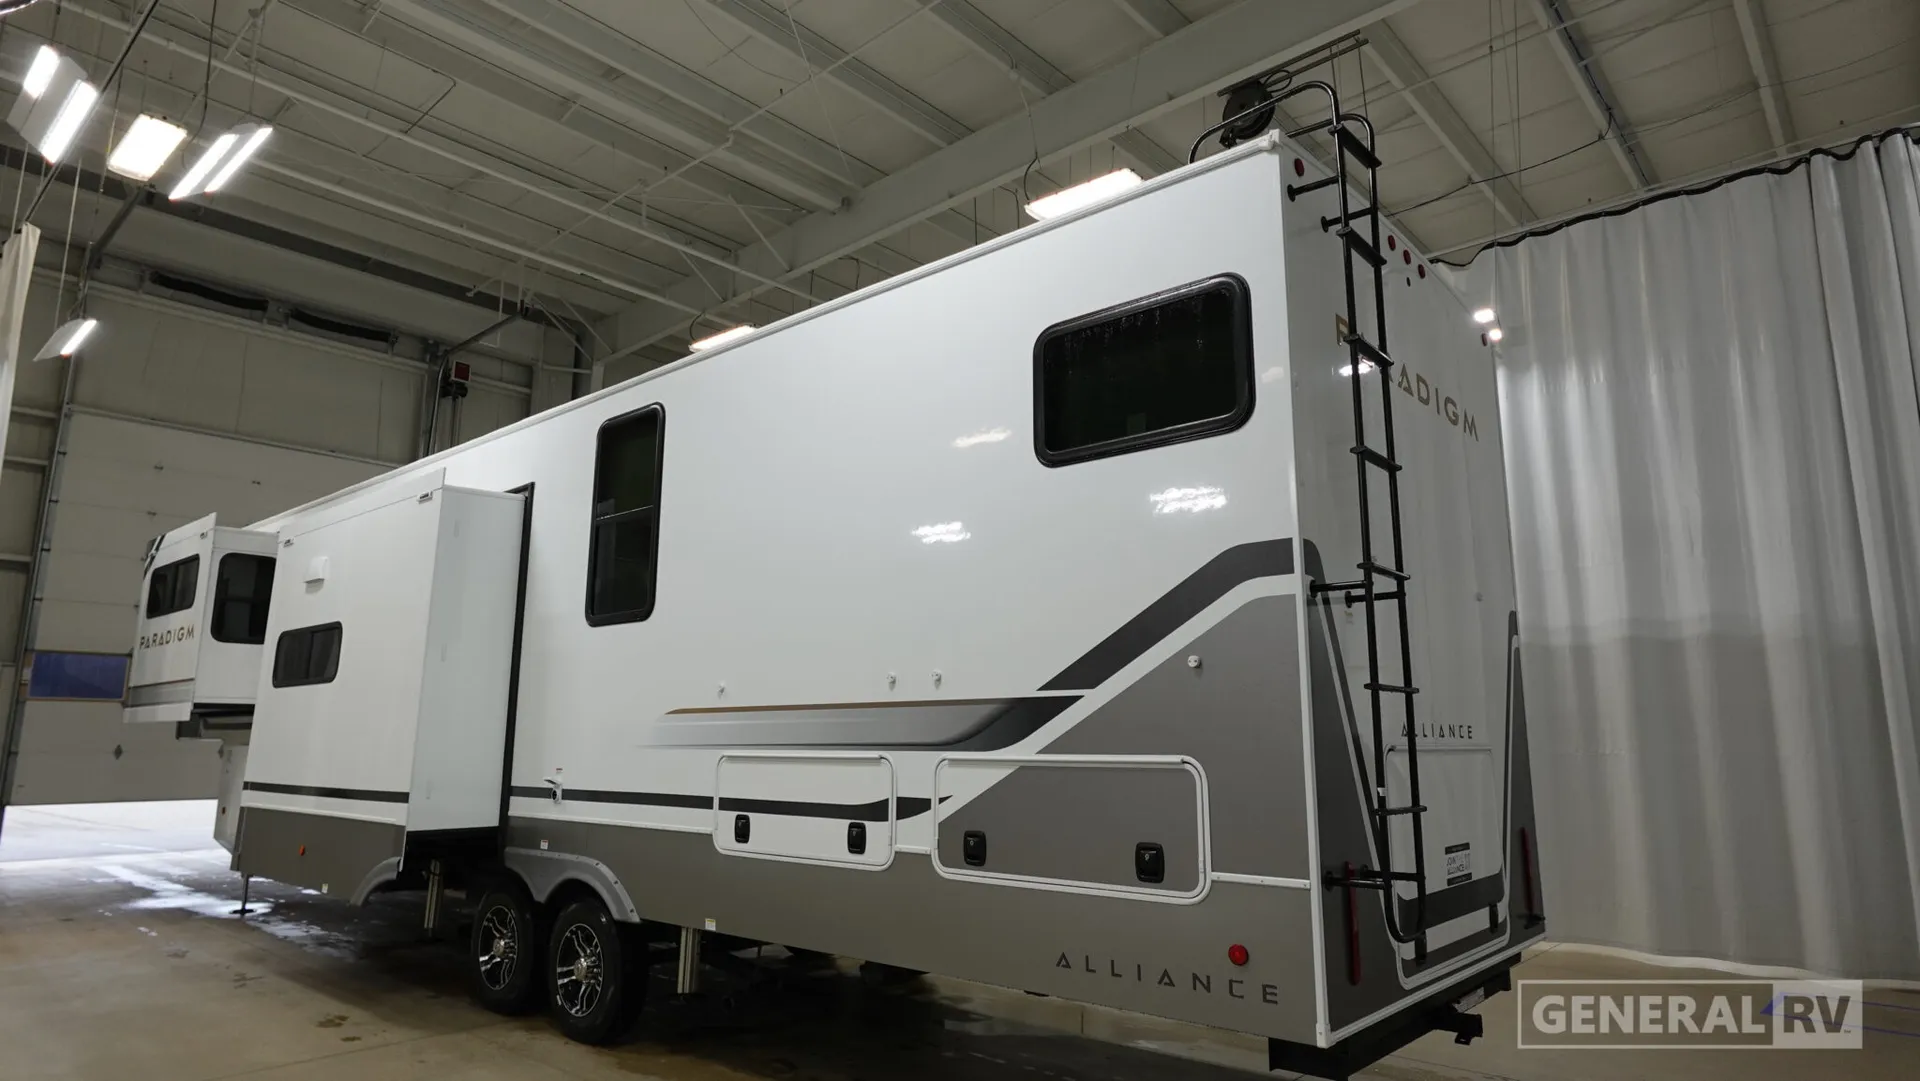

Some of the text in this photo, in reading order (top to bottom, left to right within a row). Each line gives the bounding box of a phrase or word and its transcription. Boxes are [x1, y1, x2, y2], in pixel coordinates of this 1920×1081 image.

[1336, 314, 1479, 441] PADIGM
[139, 624, 195, 650] PARADIGM
[1401, 722, 1473, 740] ALIANCE
[1055, 952, 1279, 1005] ALLIANCE
